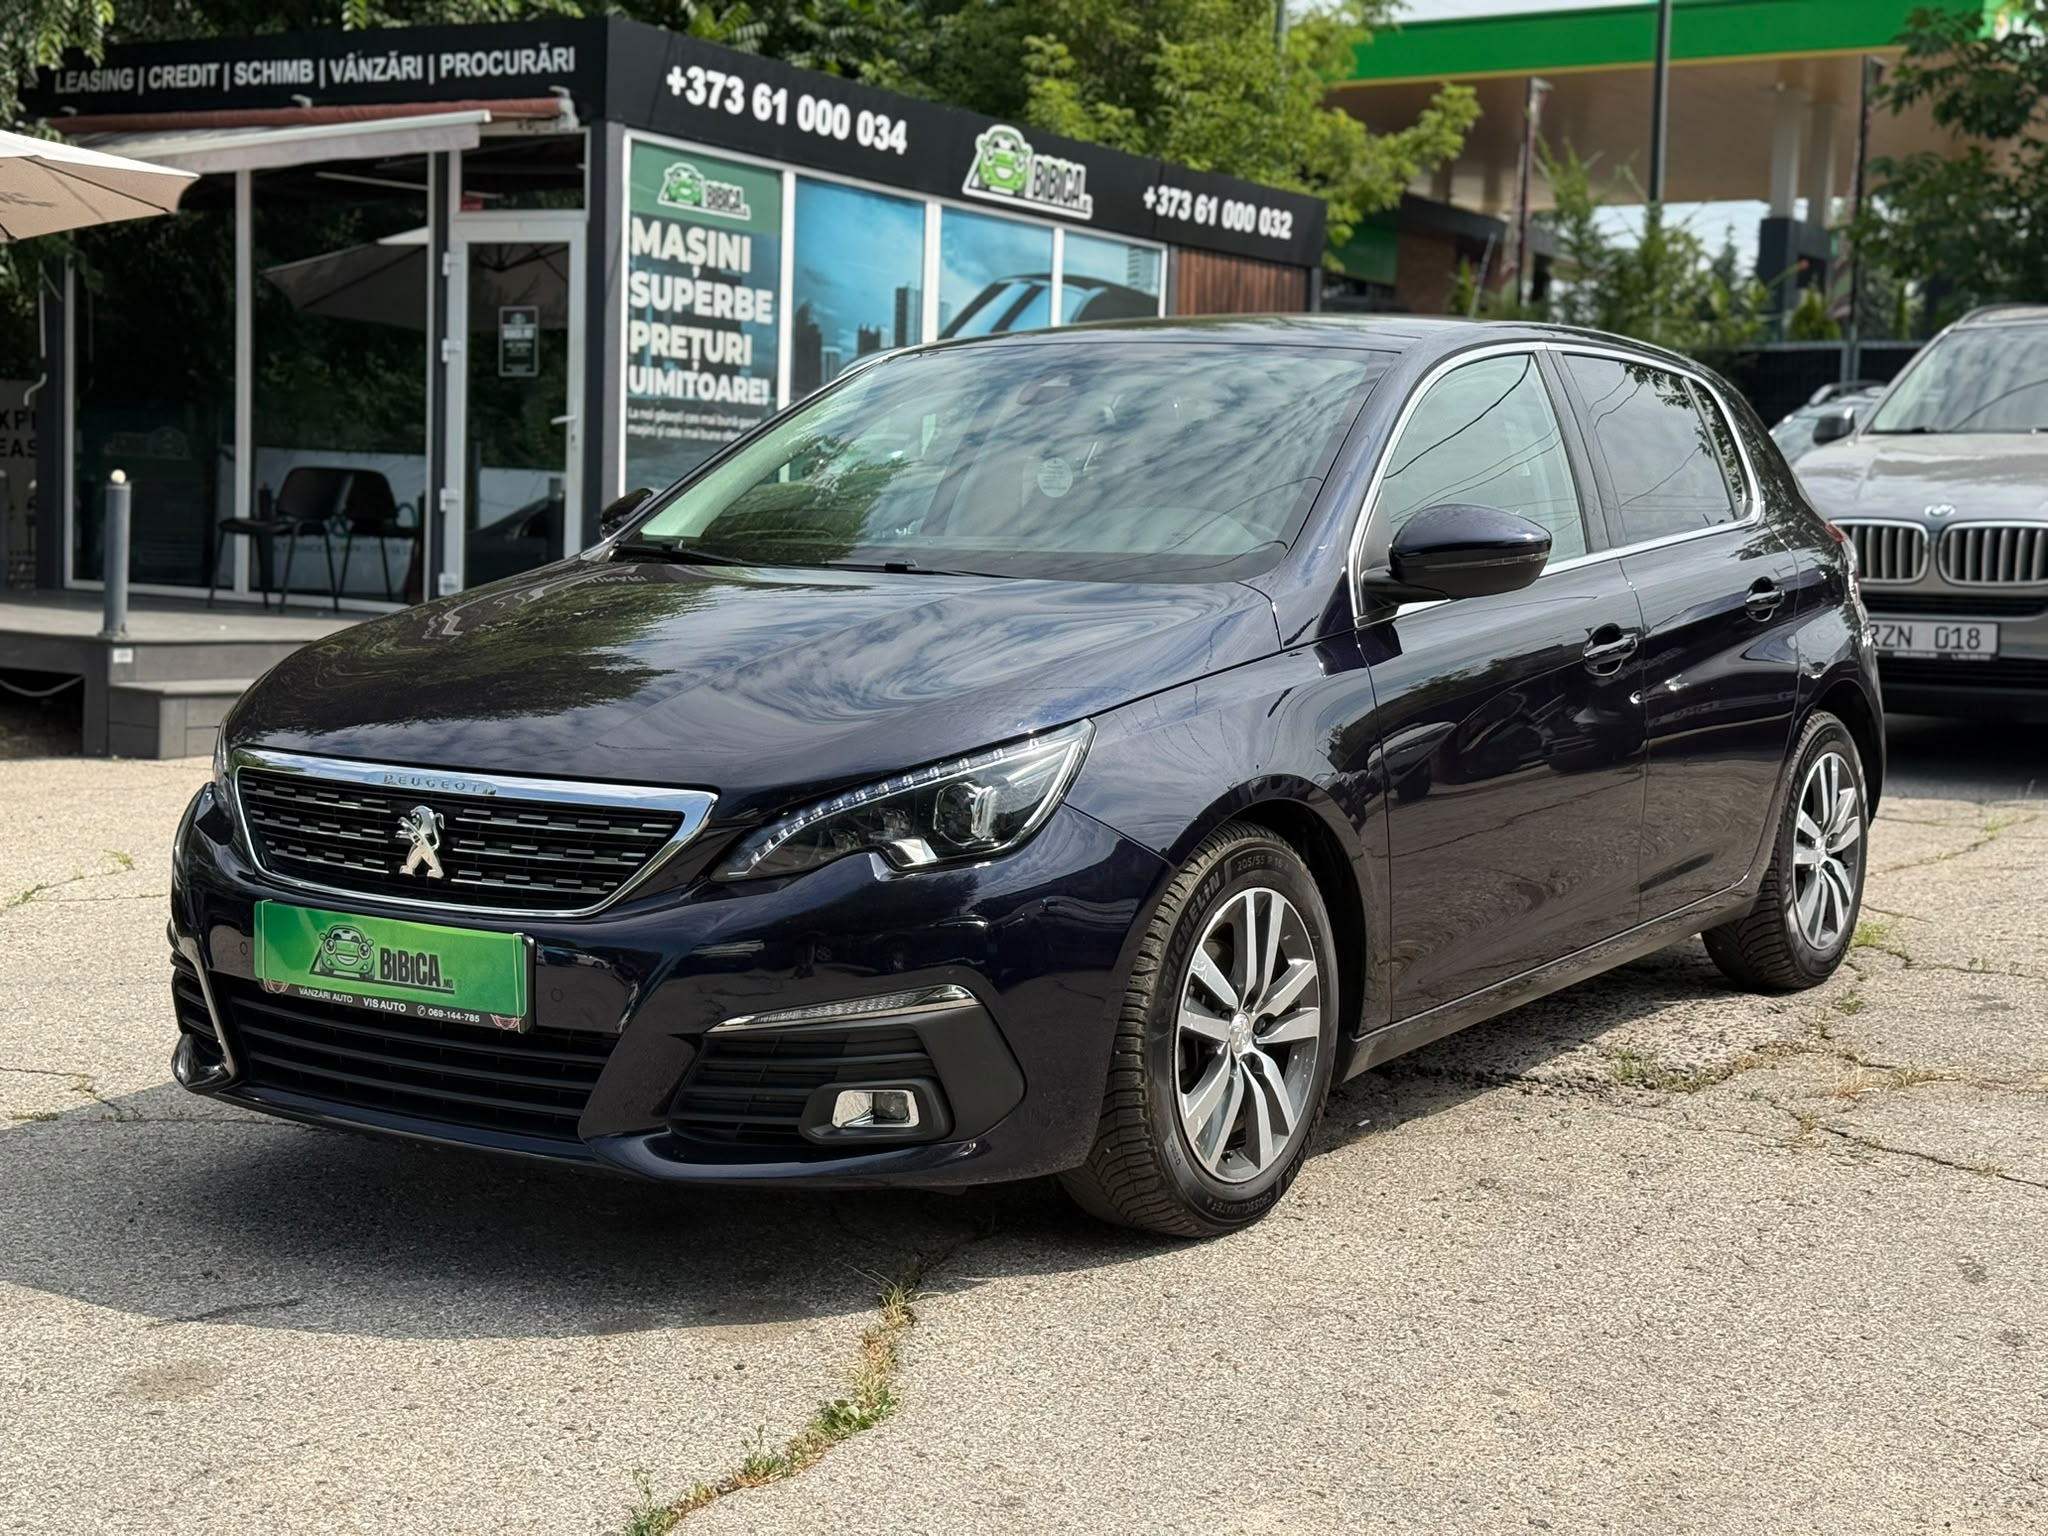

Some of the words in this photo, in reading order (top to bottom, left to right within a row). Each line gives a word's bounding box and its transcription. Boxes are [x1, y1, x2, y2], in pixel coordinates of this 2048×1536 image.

[55, 67, 135, 94] LEASING
[148, 62, 220, 89] CREDIT
[233, 58, 315, 86] SCHIMB
[329, 51, 423, 84] VÂNZĂRI
[439, 42, 576, 79] PROCURĂRI
[666, 65, 745, 115] +373
[752, 83, 788, 126] 61
[796, 95, 851, 141] 000
[856, 110, 907, 155] 034
[1143, 185, 1192, 221] +373
[1195, 193, 1218, 226] 61
[1221, 201, 1255, 233] 000
[1258, 210, 1294, 240] 032
[630, 270, 774, 325] SUPERBE
[1935, 626, 1982, 650] 018
[384, 774, 481, 792] PEUGEOT
[332, 993, 354, 1004] AUTO
[362, 996, 380, 1009] VIS
[380, 1000, 407, 1013] AUTO
[428, 1007, 480, 1023] 069-144-785
